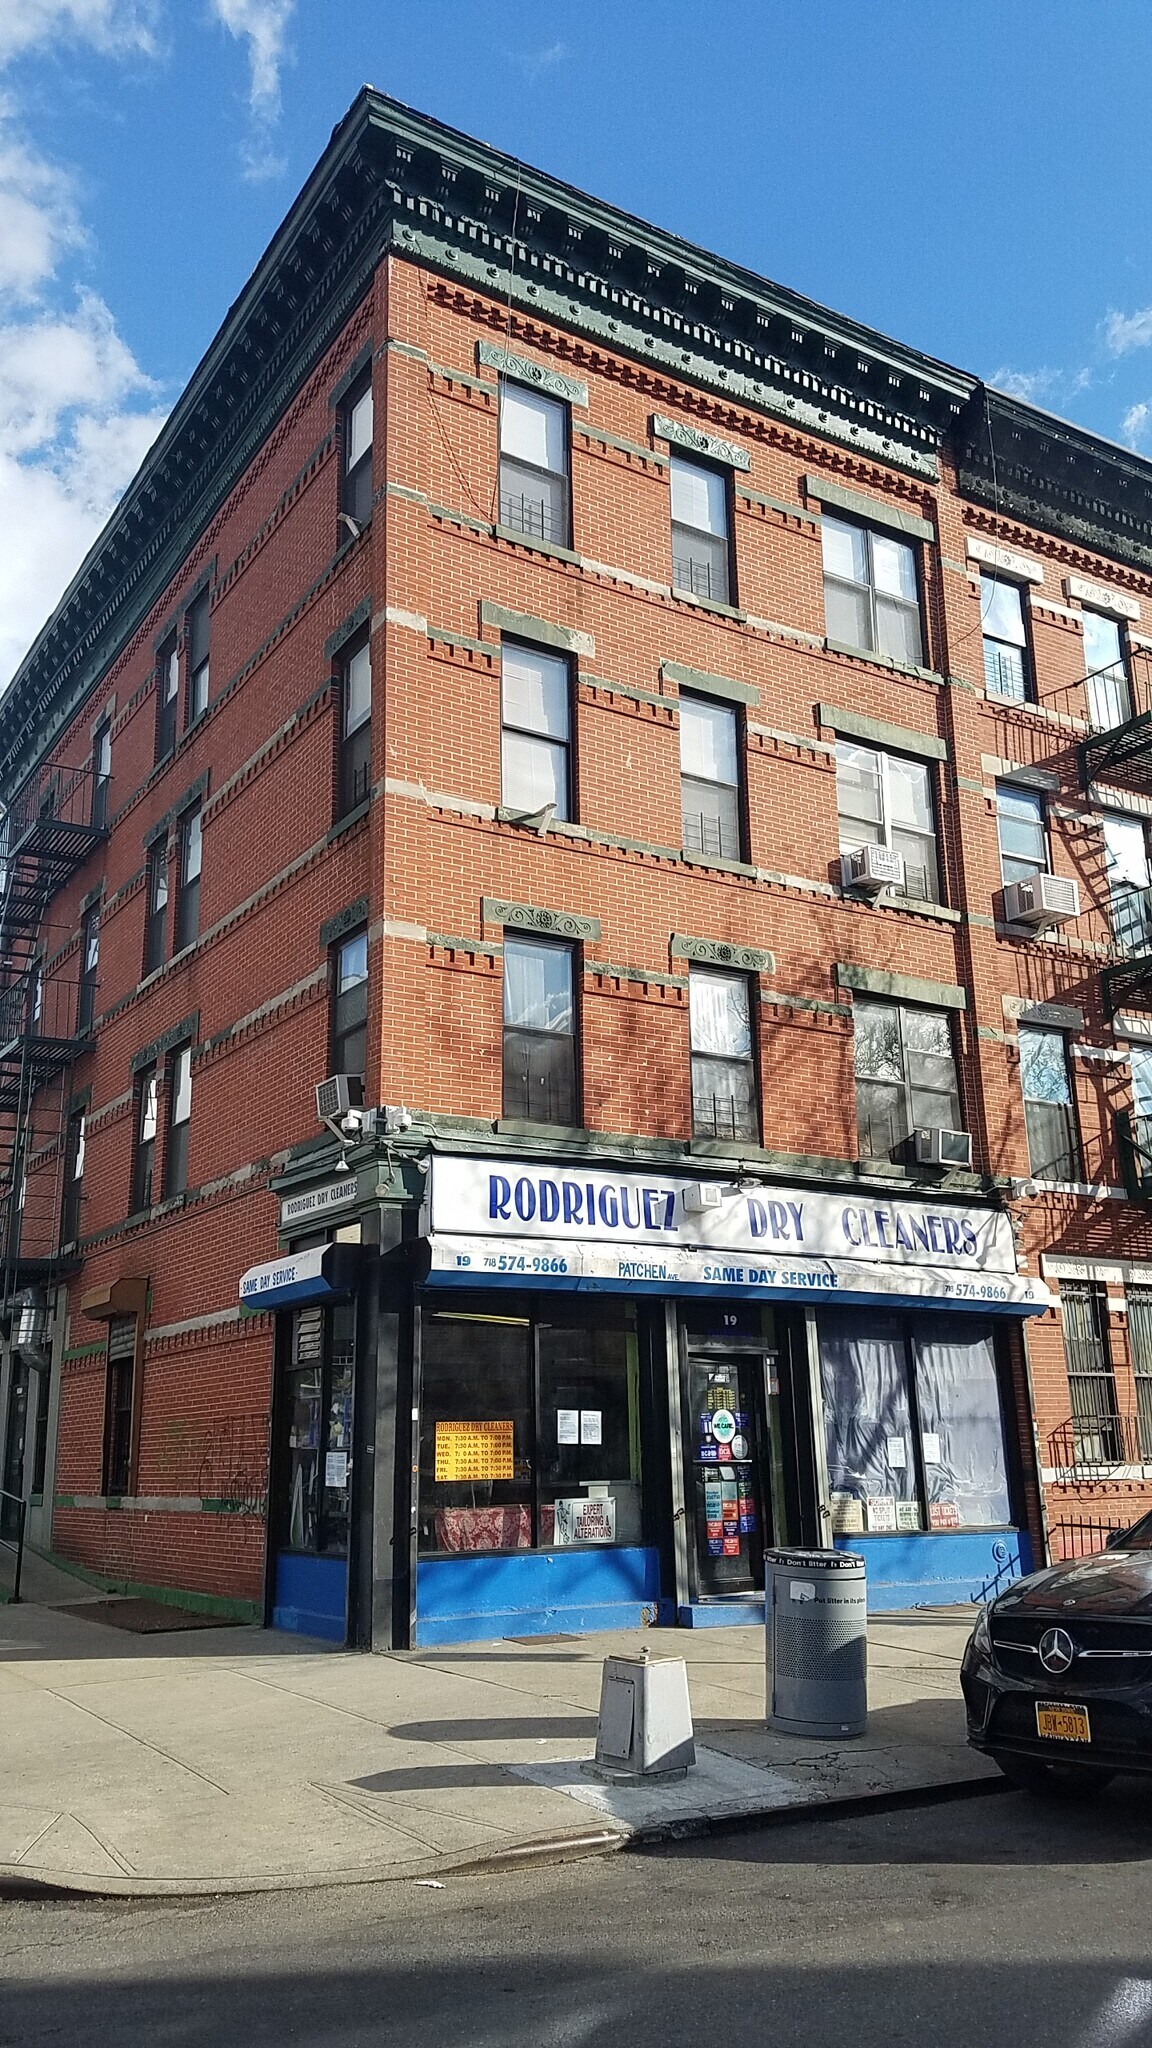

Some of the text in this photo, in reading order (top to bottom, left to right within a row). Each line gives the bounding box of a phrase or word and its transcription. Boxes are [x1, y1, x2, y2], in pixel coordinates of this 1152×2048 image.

[287, 1181, 358, 1215] RODRIGUEZ DRY CLEANERS
[490, 1175, 978, 1257] RODRIGUEZ DRY CLEANERS
[456, 1255, 471, 1266] 19
[484, 1258, 496, 1267] 718
[499, 1256, 568, 1273] 574-9866
[619, 1262, 666, 1279] PATCHEN
[243, 1267, 296, 1294] SAME DAY SERVICE
[704, 1266, 838, 1288] SAME DAY SERVICE
[956, 1284, 1006, 1300] 574-9866
[1025, 1291, 1035, 1300] 19
[723, 1315, 738, 1326] 19
[437, 1422, 513, 1432] RODRIGUEZ DRY CLEANERS
[583, 1503, 603, 1515] EXPERT
[576, 1515, 610, 1527] TAILORING &
[574, 1525, 612, 1539] ALTERATIONS
[787, 1559, 807, 1567] Don't
[828, 1596, 843, 1605] litter
